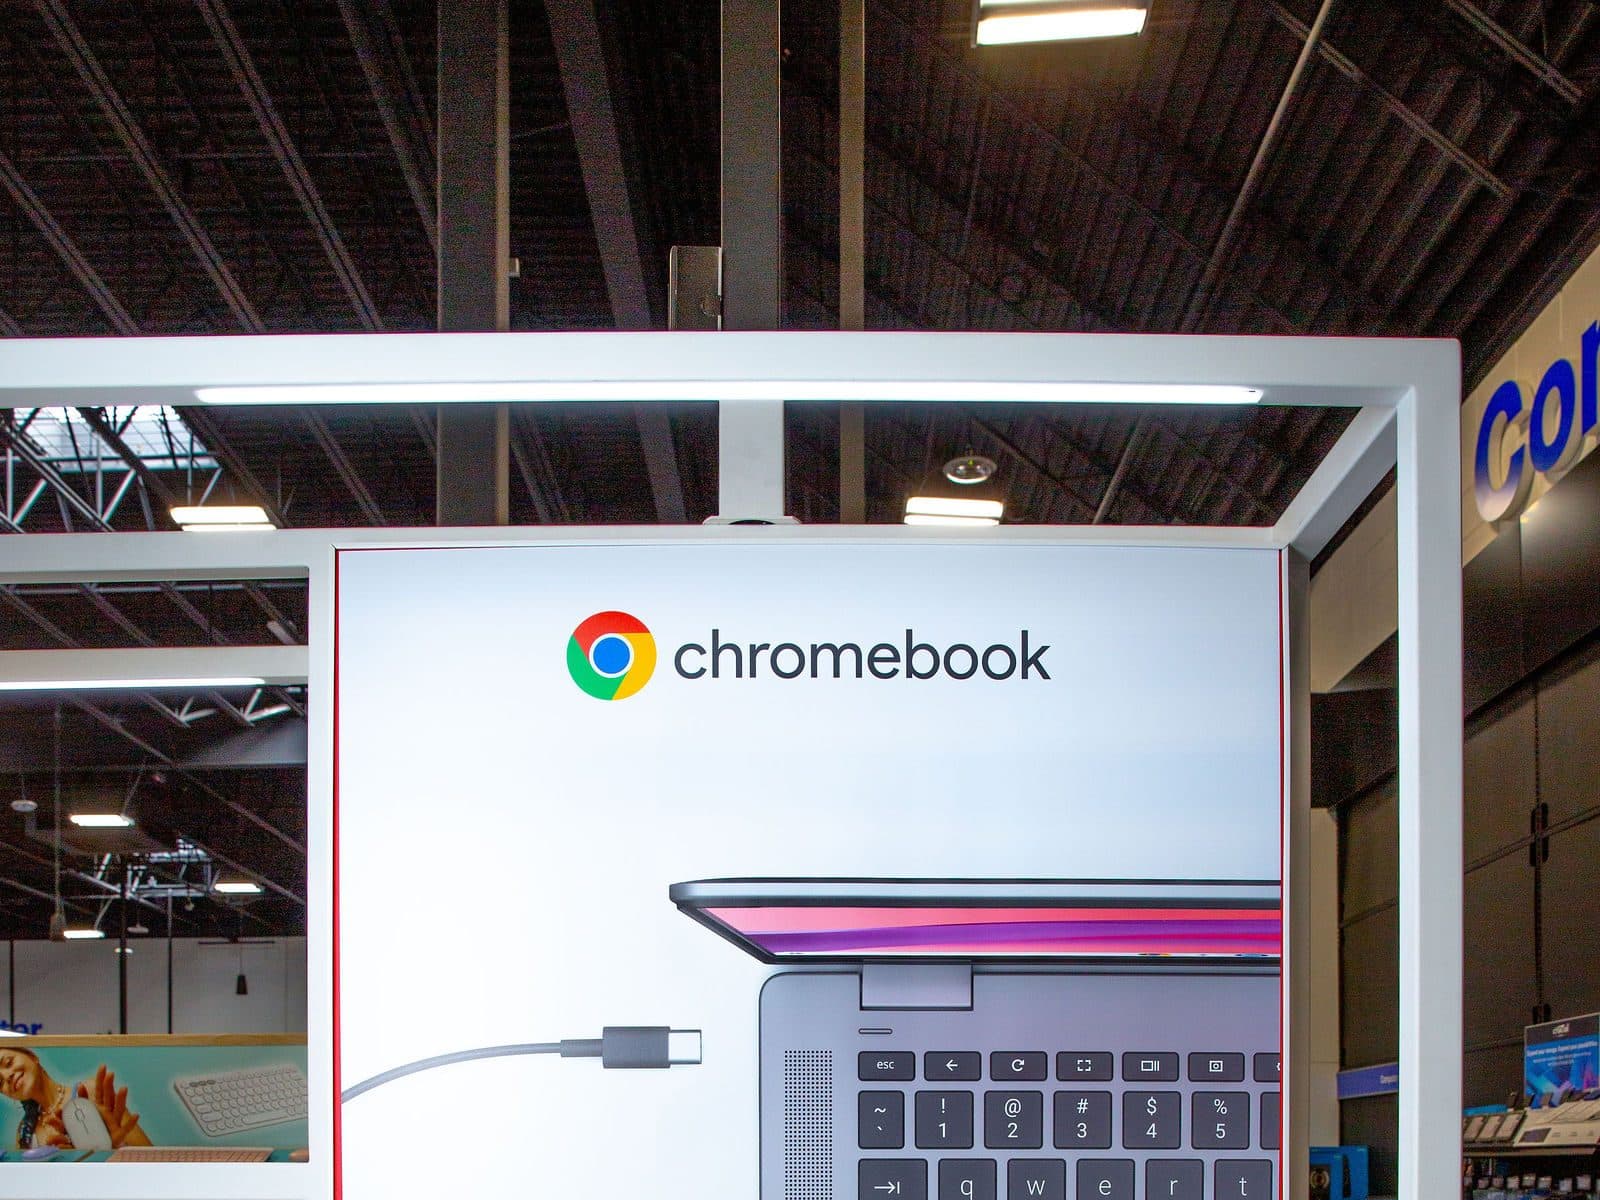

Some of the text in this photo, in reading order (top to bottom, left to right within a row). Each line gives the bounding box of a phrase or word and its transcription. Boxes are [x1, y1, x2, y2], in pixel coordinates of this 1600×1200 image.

[674, 628, 1052, 681] chromebook
[876, 1061, 895, 1070] esc
[1004, 1098, 1022, 1118] @
[1076, 1098, 1089, 1114] #
[1146, 1096, 1157, 1116] $
[1214, 1098, 1228, 1115] %
[938, 1122, 946, 1138] 1
[1007, 1122, 1019, 1138] 2
[1076, 1122, 1087, 1138] 3
[1145, 1122, 1158, 1139] 4
[1215, 1123, 1226, 1139] 5
[960, 1179, 973, 1200] q
[1098, 1179, 1112, 1196] e
[1170, 1179, 1179, 1196] r
[1238, 1177, 1248, 1197] t
